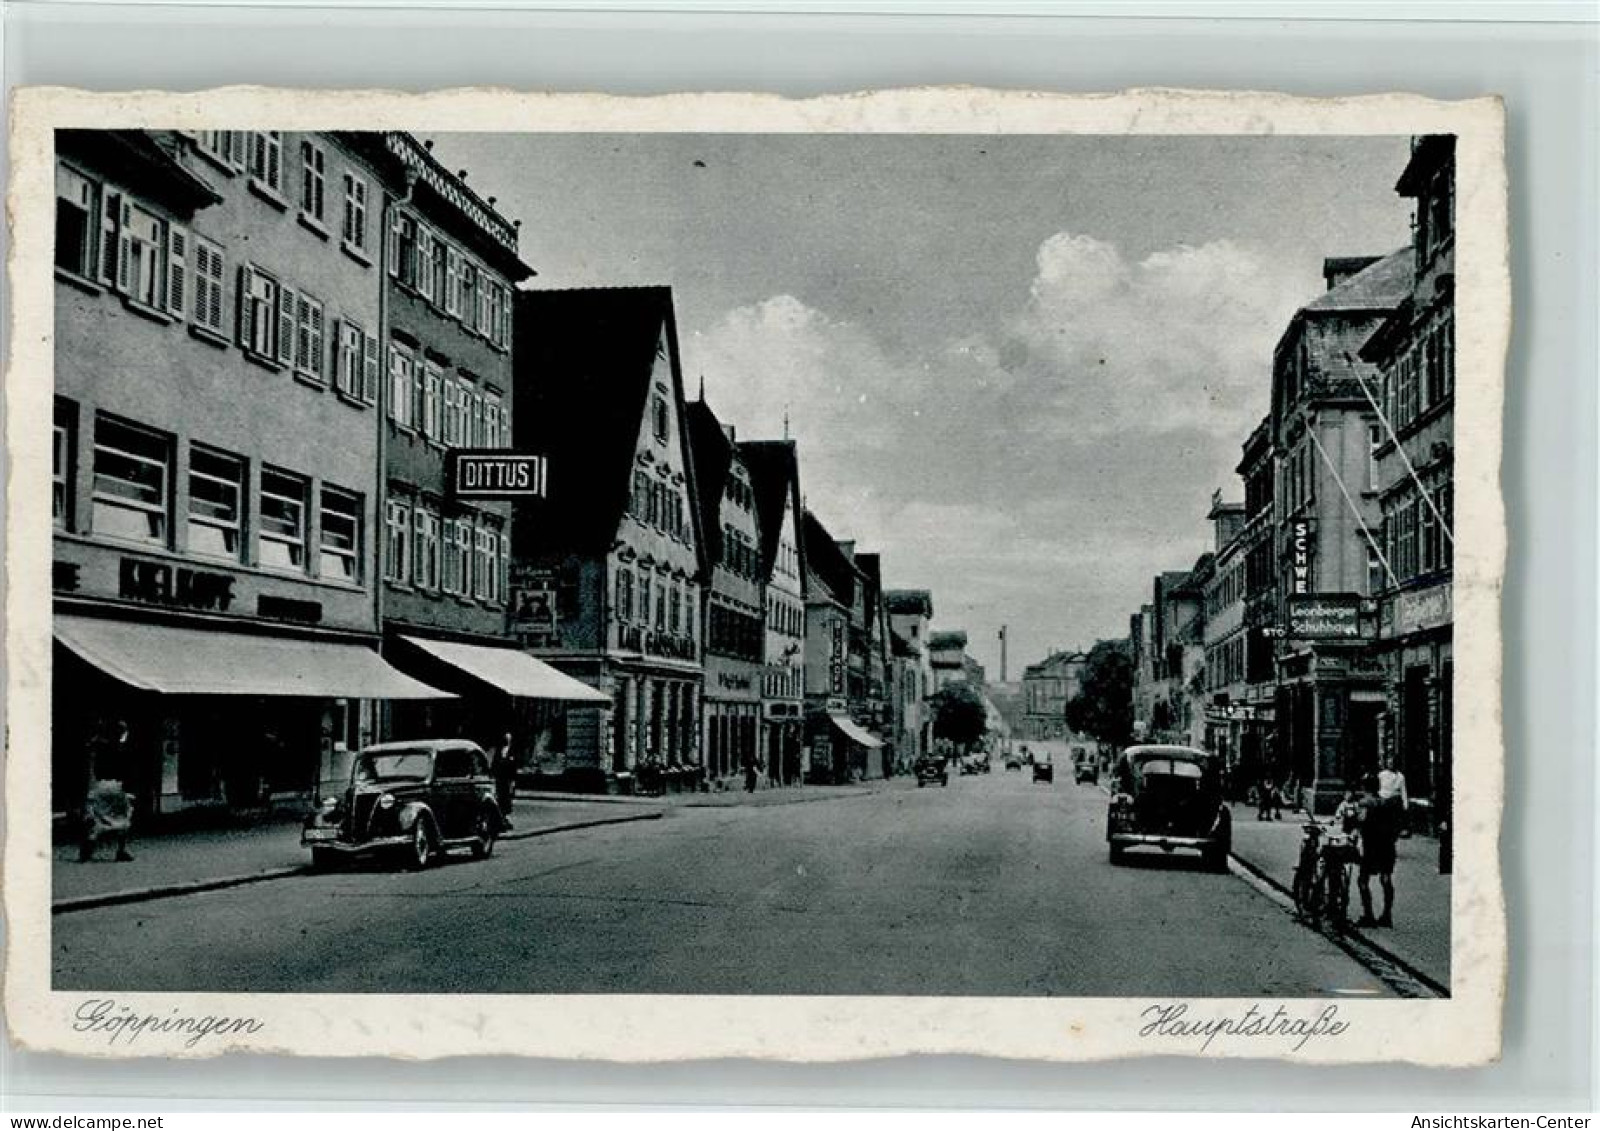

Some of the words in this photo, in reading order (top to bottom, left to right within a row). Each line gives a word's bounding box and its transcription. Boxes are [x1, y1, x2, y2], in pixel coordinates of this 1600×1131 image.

[466, 462, 529, 487] DITTUS
[1290, 603, 1357, 619] Leonberger
[73, 999, 264, 1048] Göppingen
[1139, 1003, 1351, 1052] Hauptstraße
